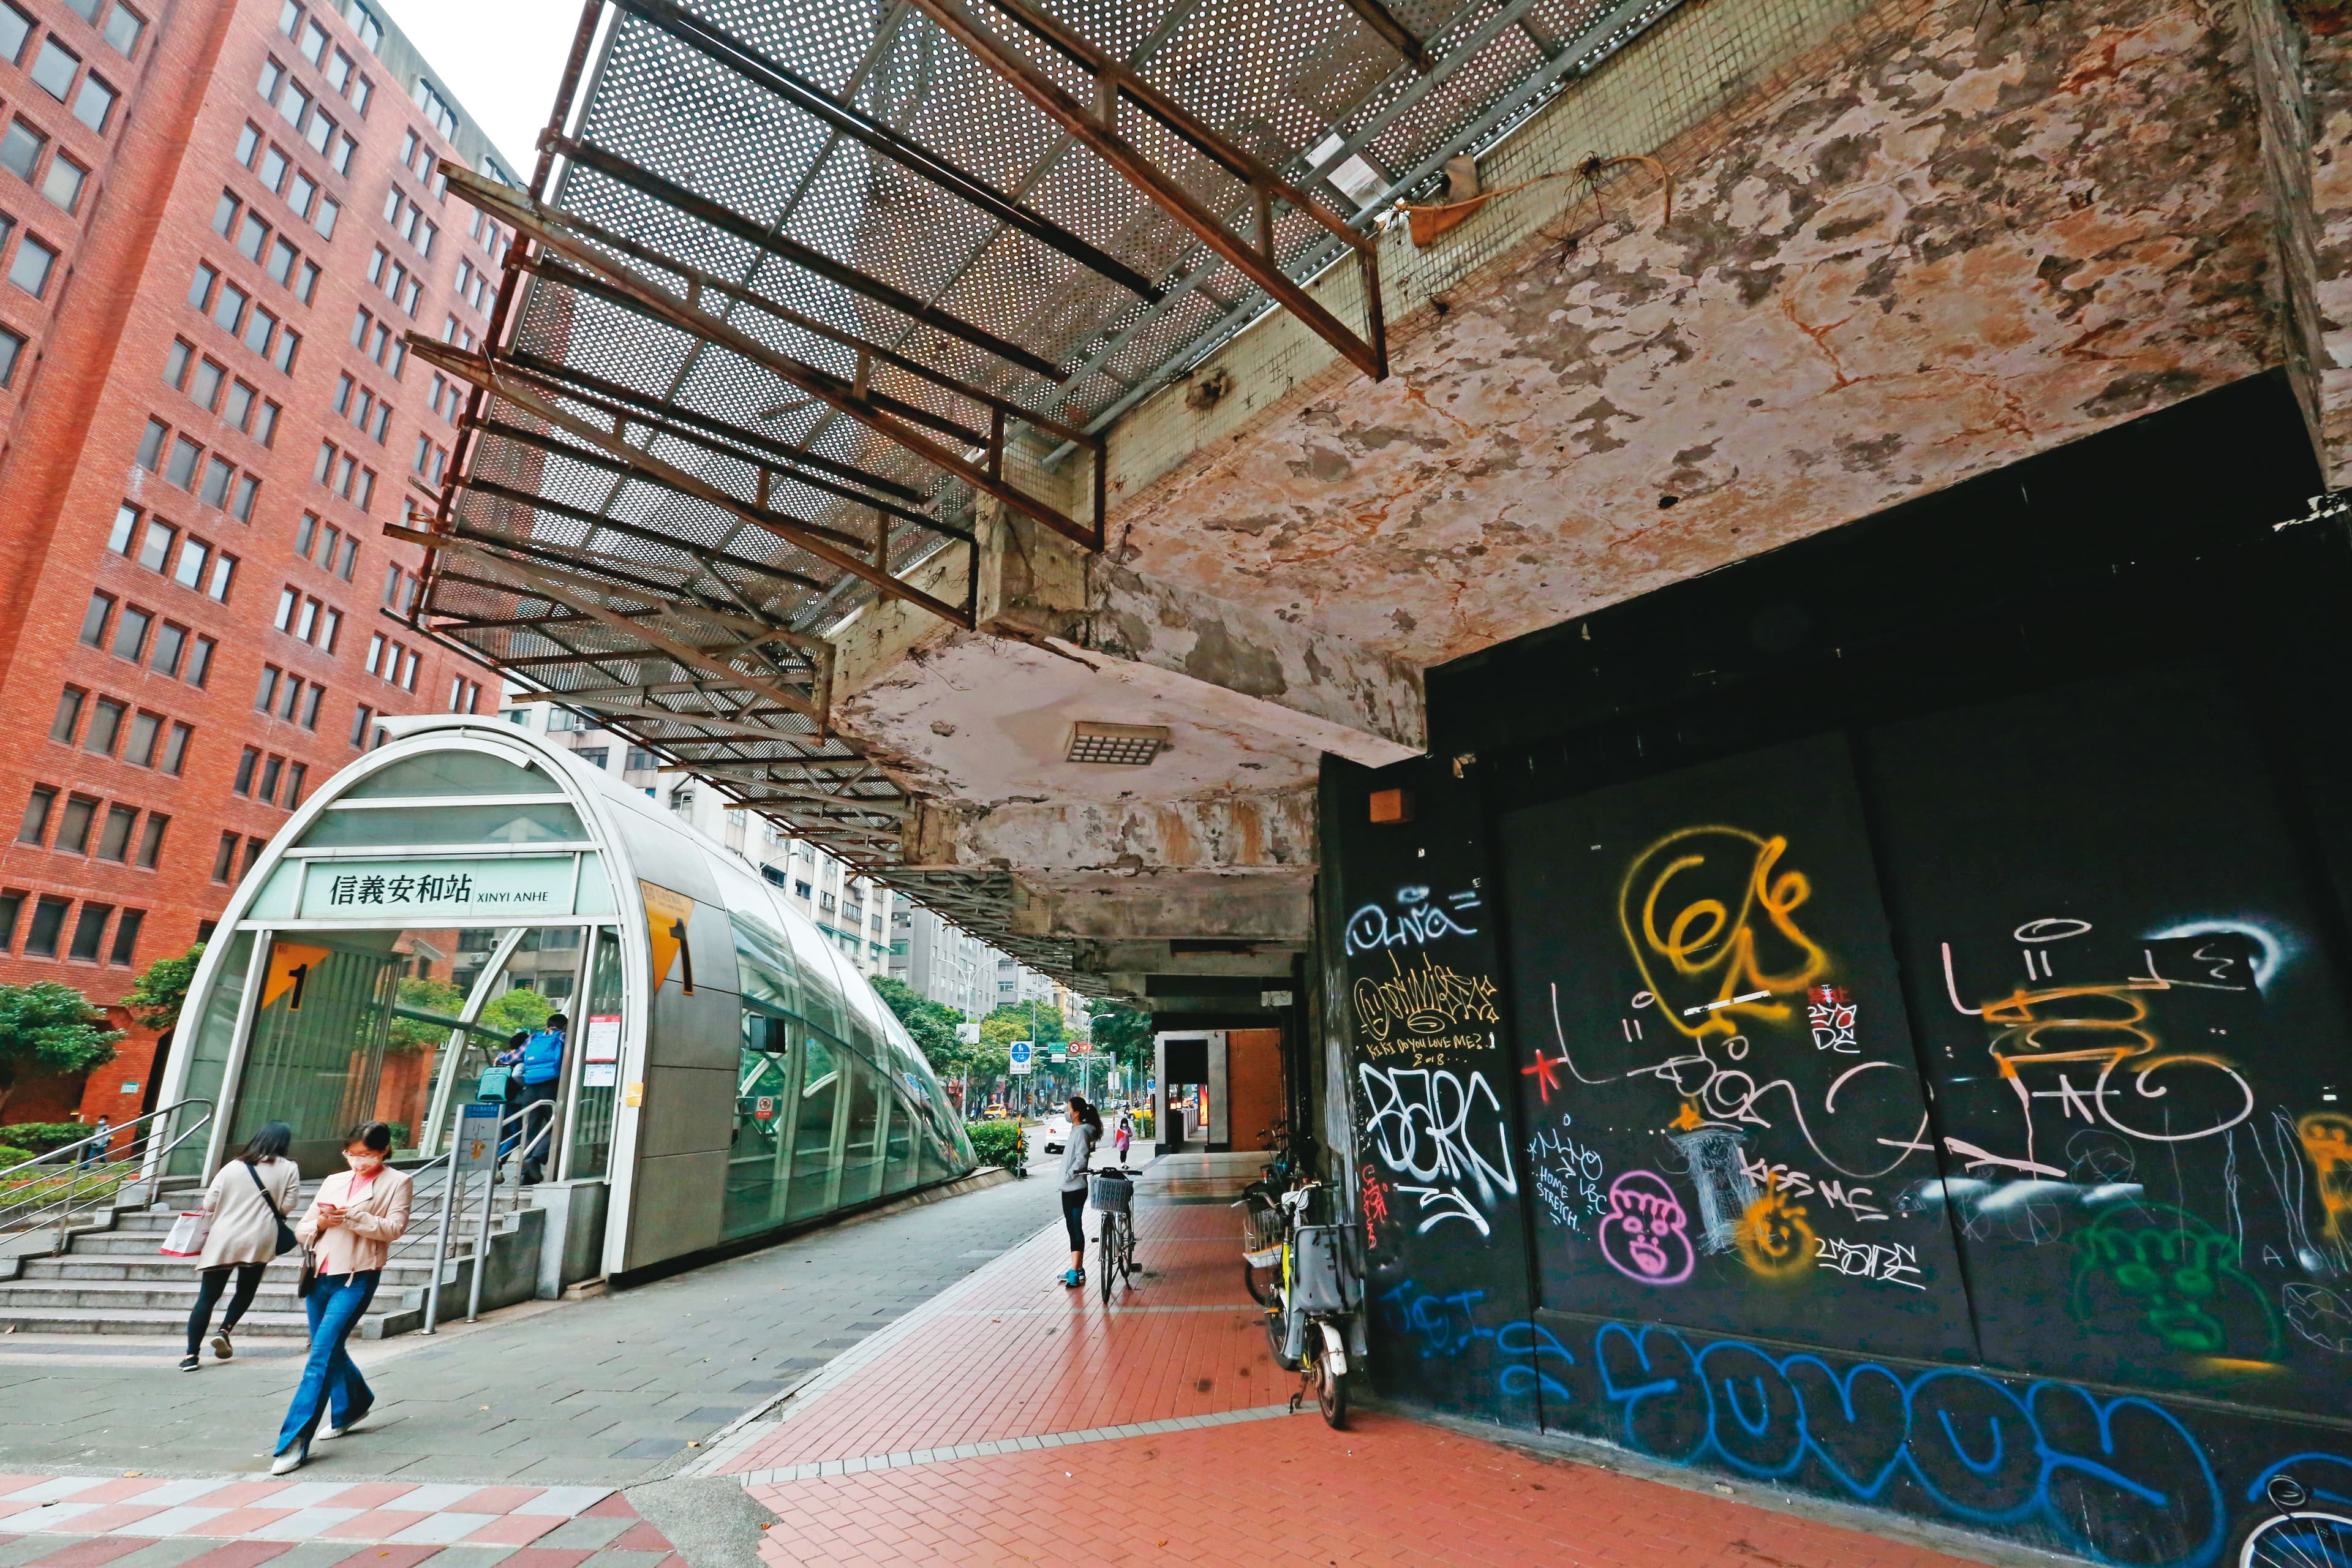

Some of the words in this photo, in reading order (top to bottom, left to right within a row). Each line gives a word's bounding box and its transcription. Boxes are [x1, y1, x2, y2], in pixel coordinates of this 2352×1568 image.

[330, 873, 472, 905] 信義安和站
[477, 892, 510, 902] XINYI
[513, 892, 549, 902] ANHE
[669, 917, 694, 995] 1
[288, 963, 308, 1011] 1
[1428, 1036, 1451, 1049] LOVE
[1540, 1166, 1569, 1198] HOME
